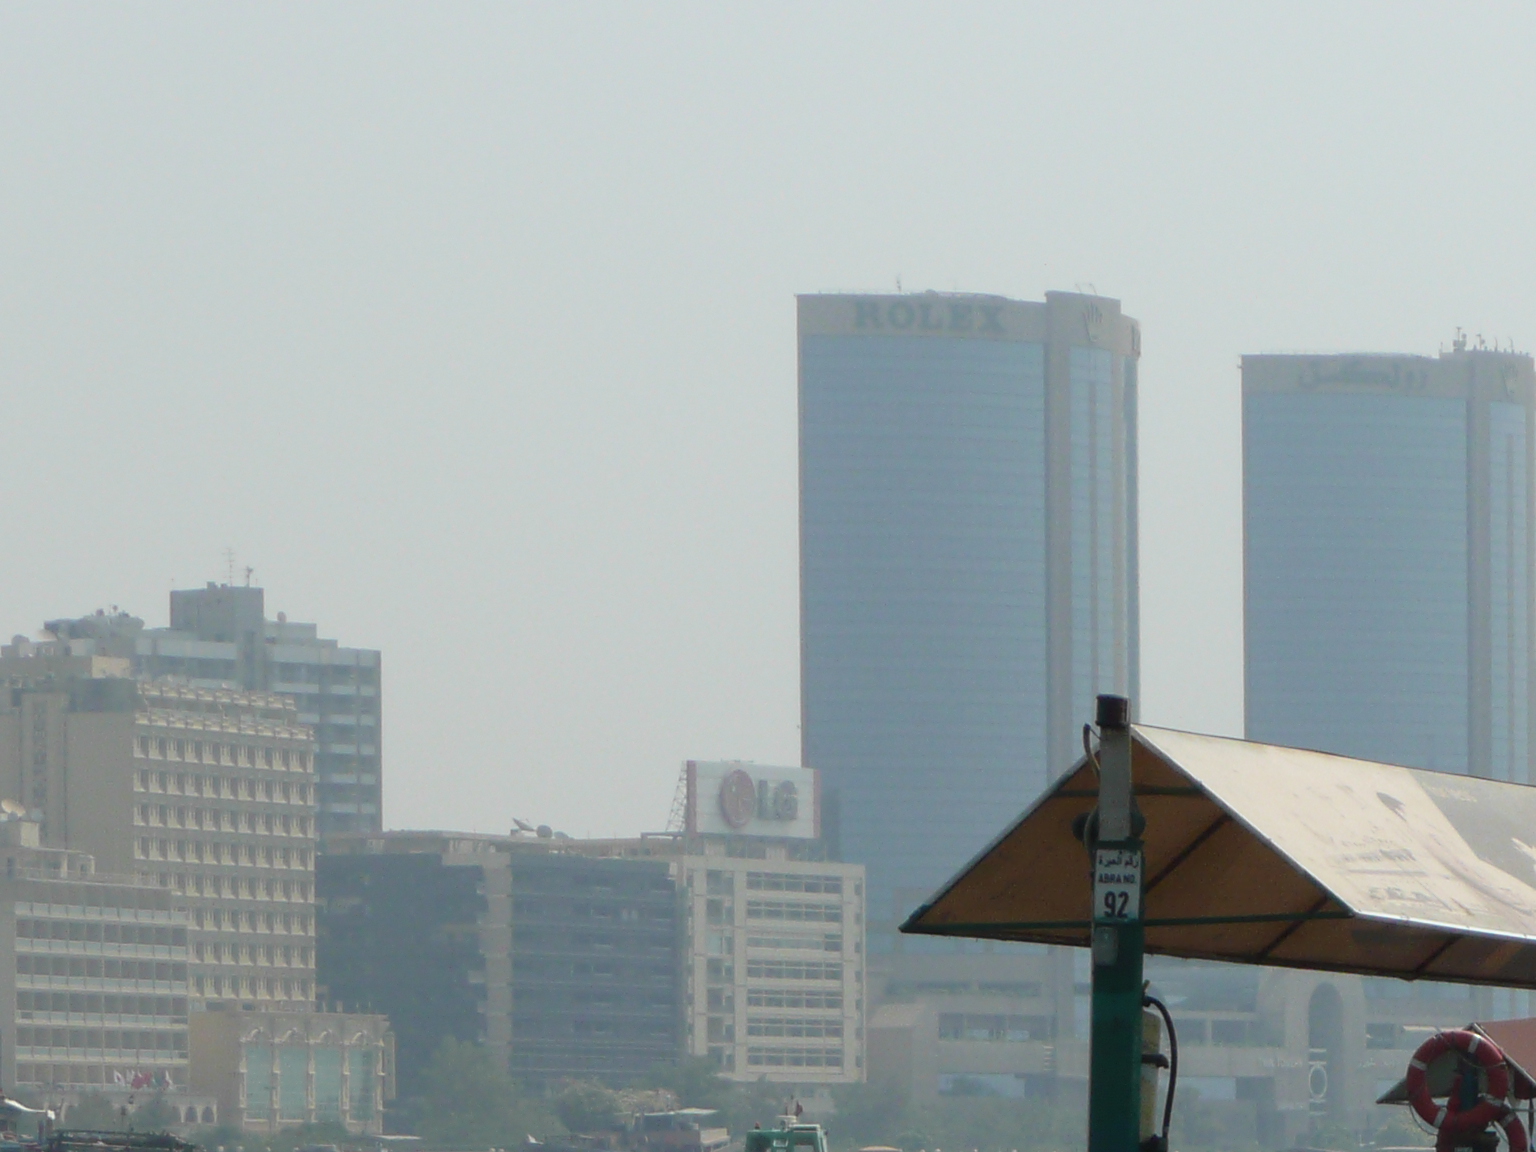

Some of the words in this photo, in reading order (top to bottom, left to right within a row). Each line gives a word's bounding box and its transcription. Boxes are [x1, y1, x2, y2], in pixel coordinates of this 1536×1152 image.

[854, 300, 1007, 334] ROLEX
[757, 779, 798, 821] LG
[1098, 873, 1122, 884] ABRA
[1103, 890, 1129, 919] 92
